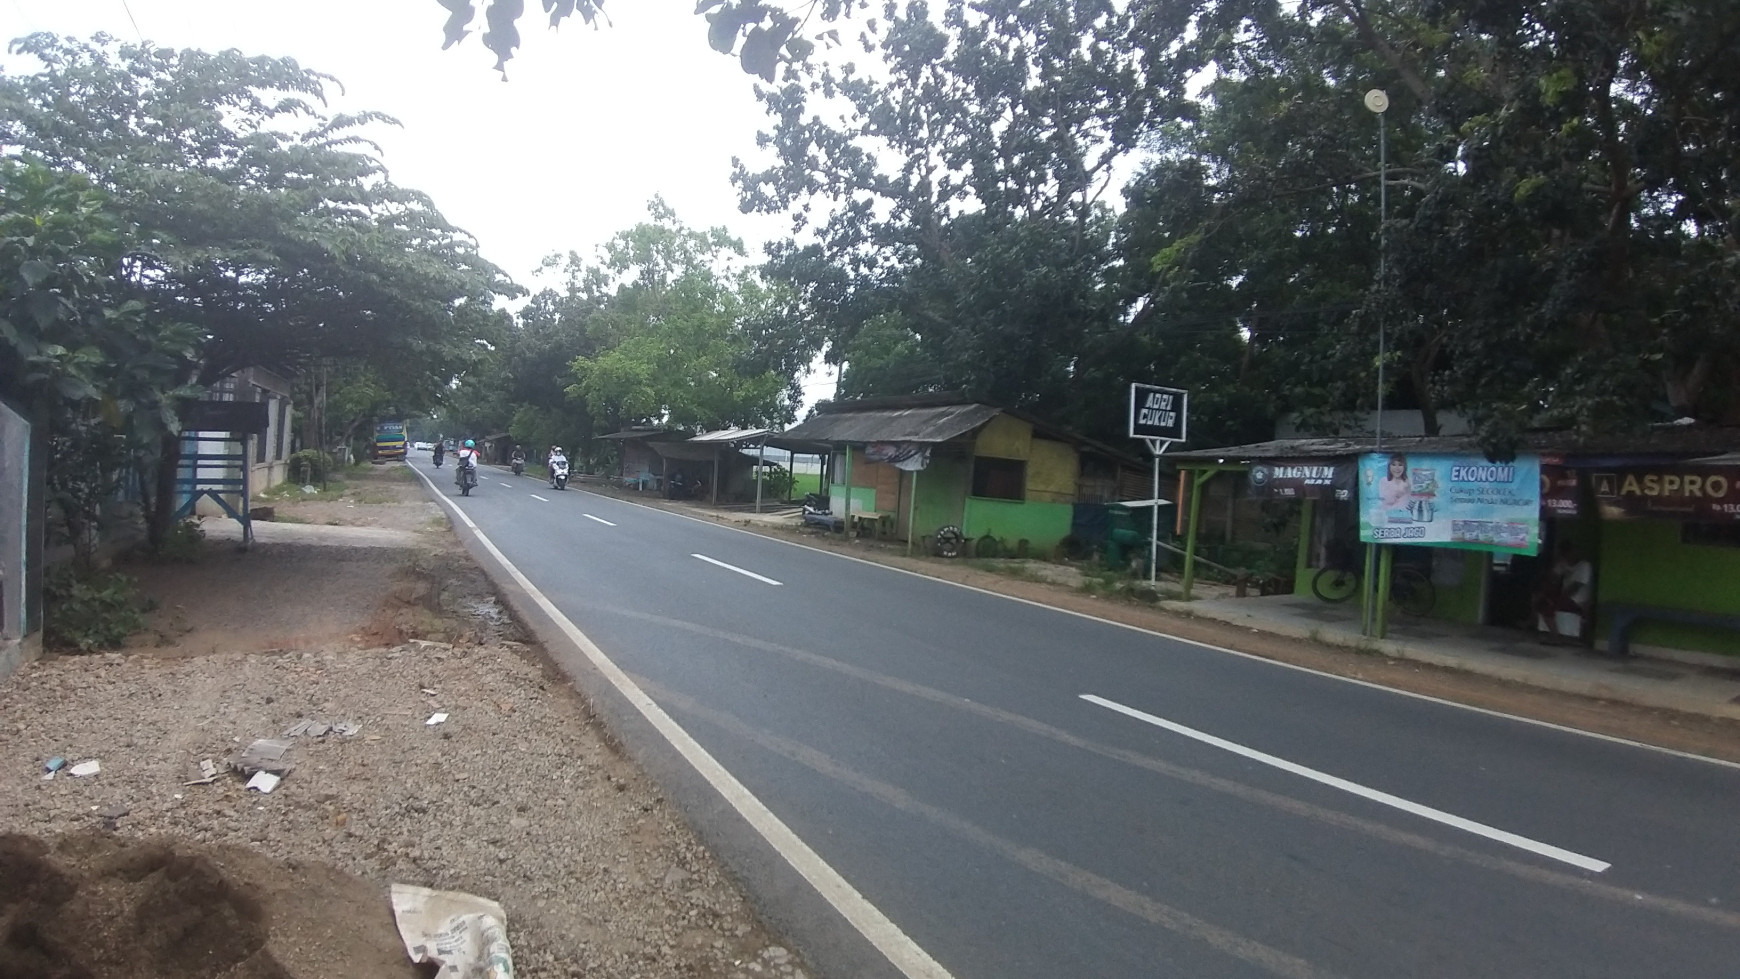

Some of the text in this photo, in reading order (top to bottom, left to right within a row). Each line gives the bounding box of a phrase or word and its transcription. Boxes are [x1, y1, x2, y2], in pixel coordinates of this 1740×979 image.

[1145, 392, 1174, 410] ADRI
[1138, 408, 1177, 427] CUKUR
[1273, 466, 1335, 479] MAGNUM
[1451, 466, 1515, 482] EKONOMI
[1620, 474, 1729, 498] ASPRO
[1402, 526, 1426, 539] JAGO
